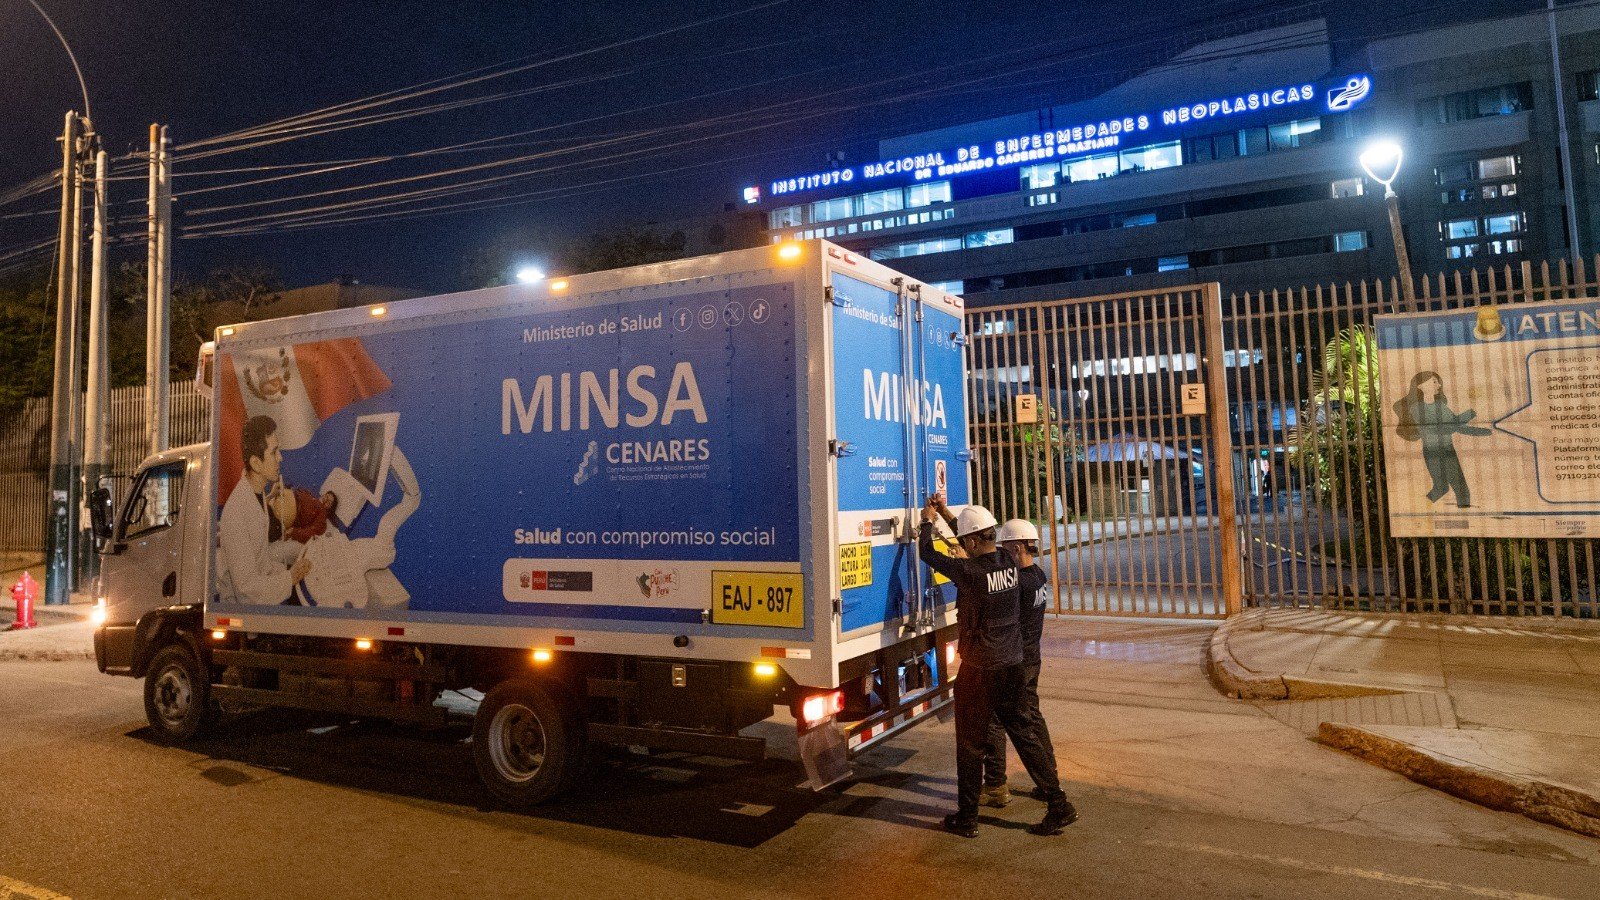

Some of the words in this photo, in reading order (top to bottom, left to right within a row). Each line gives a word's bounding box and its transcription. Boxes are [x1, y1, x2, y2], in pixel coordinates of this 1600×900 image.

[772, 169, 853, 195] INSTITUTO
[864, 152, 945, 178] NACIONAL
[957, 146, 979, 162] DE
[996, 115, 1148, 155] ENFERMEDADES
[1163, 84, 1314, 125] NEOPLASICAS
[843, 301, 878, 324] Ministerio
[879, 312, 888, 326] de
[523, 322, 594, 342] Ministerio
[599, 319, 617, 335] de
[620, 312, 662, 333] Salud
[1546, 375, 1574, 383] pagos
[502, 361, 708, 435] MINSA
[864, 368, 947, 429] MINSA
[1547, 392, 1584, 400] cuentas
[1576, 403, 1596, 412] deje
[1560, 413, 1596, 422] proceso
[606, 439, 710, 464] CENARES
[869, 456, 886, 467] Salud
[887, 459, 898, 467] con
[869, 483, 886, 494] social
[514, 528, 562, 546] Salud
[566, 532, 597, 546] con
[601, 527, 715, 549] compromiso
[720, 527, 775, 546] social
[986, 567, 1018, 593] MINSA
[722, 585, 752, 611] EAJ
[767, 587, 793, 613] 897
